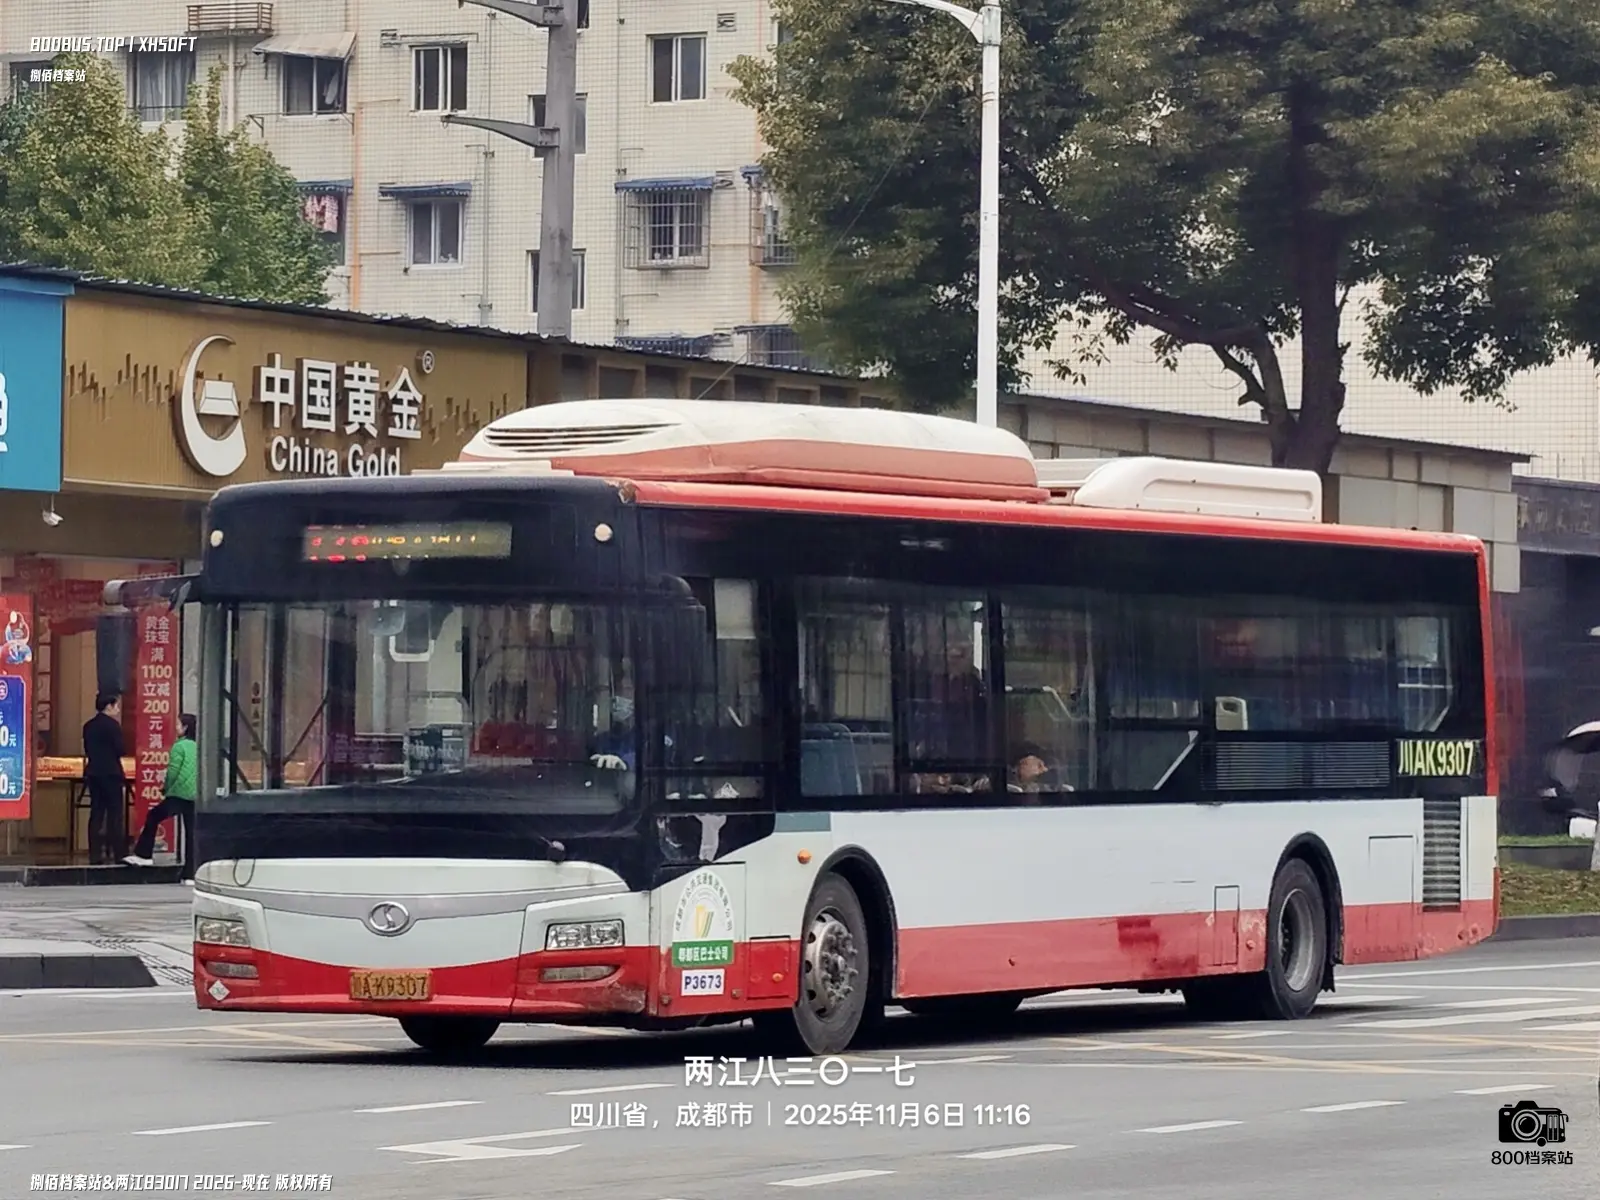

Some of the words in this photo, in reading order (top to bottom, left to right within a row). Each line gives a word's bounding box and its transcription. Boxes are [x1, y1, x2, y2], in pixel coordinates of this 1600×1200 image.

[258, 352, 423, 440] 中国黄金
[270, 435, 339, 476] China
[347, 443, 400, 478] Gold
[145, 616, 169, 629] 黄金
[145, 630, 169, 644] 珠宝
[150, 647, 164, 662] 满
[141, 664, 173, 678] 1100
[143, 681, 170, 697] 立减
[143, 699, 170, 714] 200
[149, 715, 163, 731] 元
[149, 733, 163, 749] 满
[141, 751, 170, 765] 2200
[1398, 739, 1474, 776] 川AK9307
[684, 974, 722, 990] P3673
